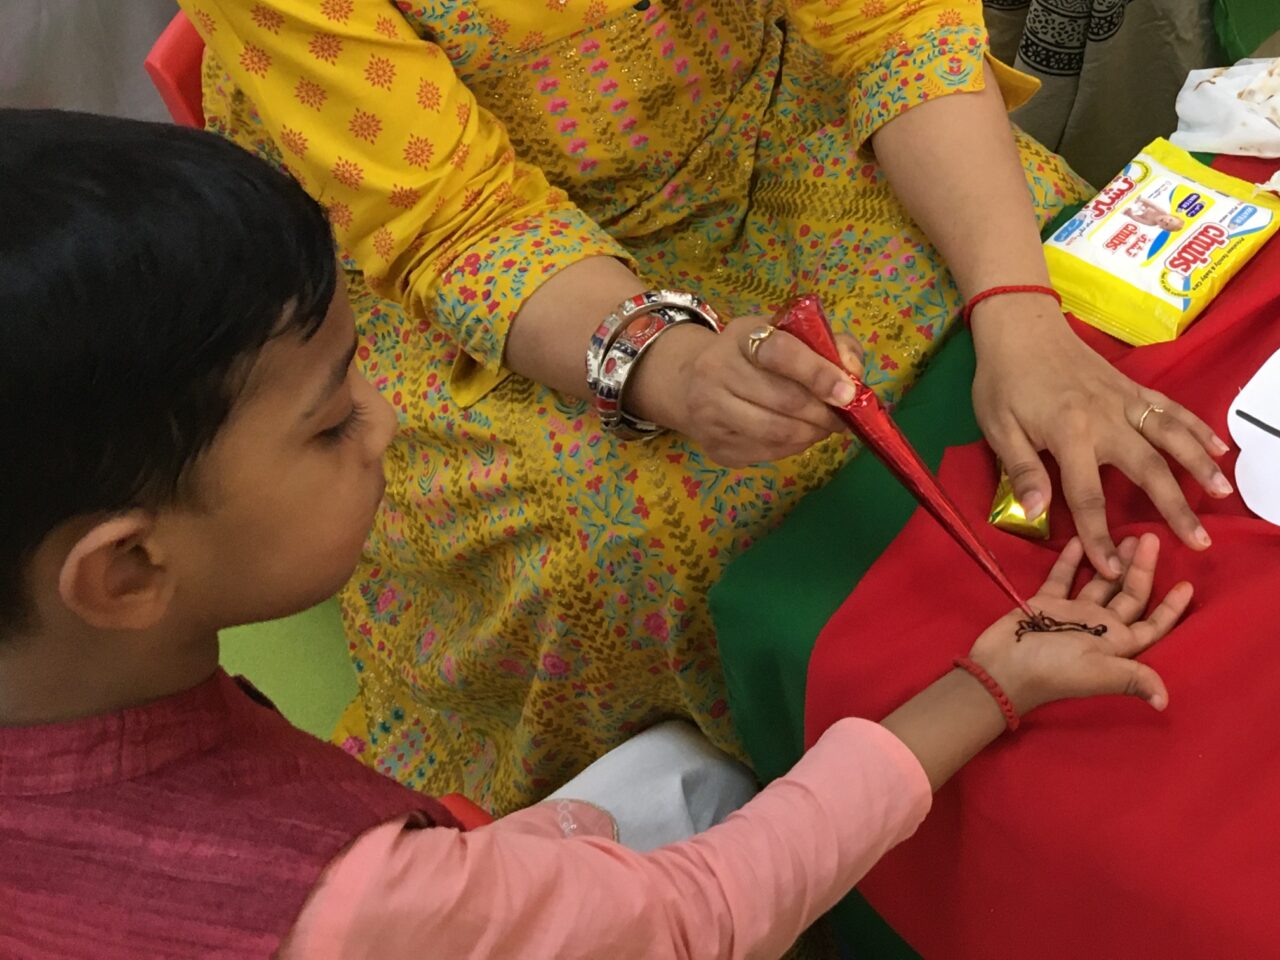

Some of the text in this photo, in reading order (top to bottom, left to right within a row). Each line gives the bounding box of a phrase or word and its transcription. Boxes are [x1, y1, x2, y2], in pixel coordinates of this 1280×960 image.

[1235, 205, 1255, 227] WATER
[1104, 223, 1138, 250] chubs
[1168, 224, 1227, 275] chubs
